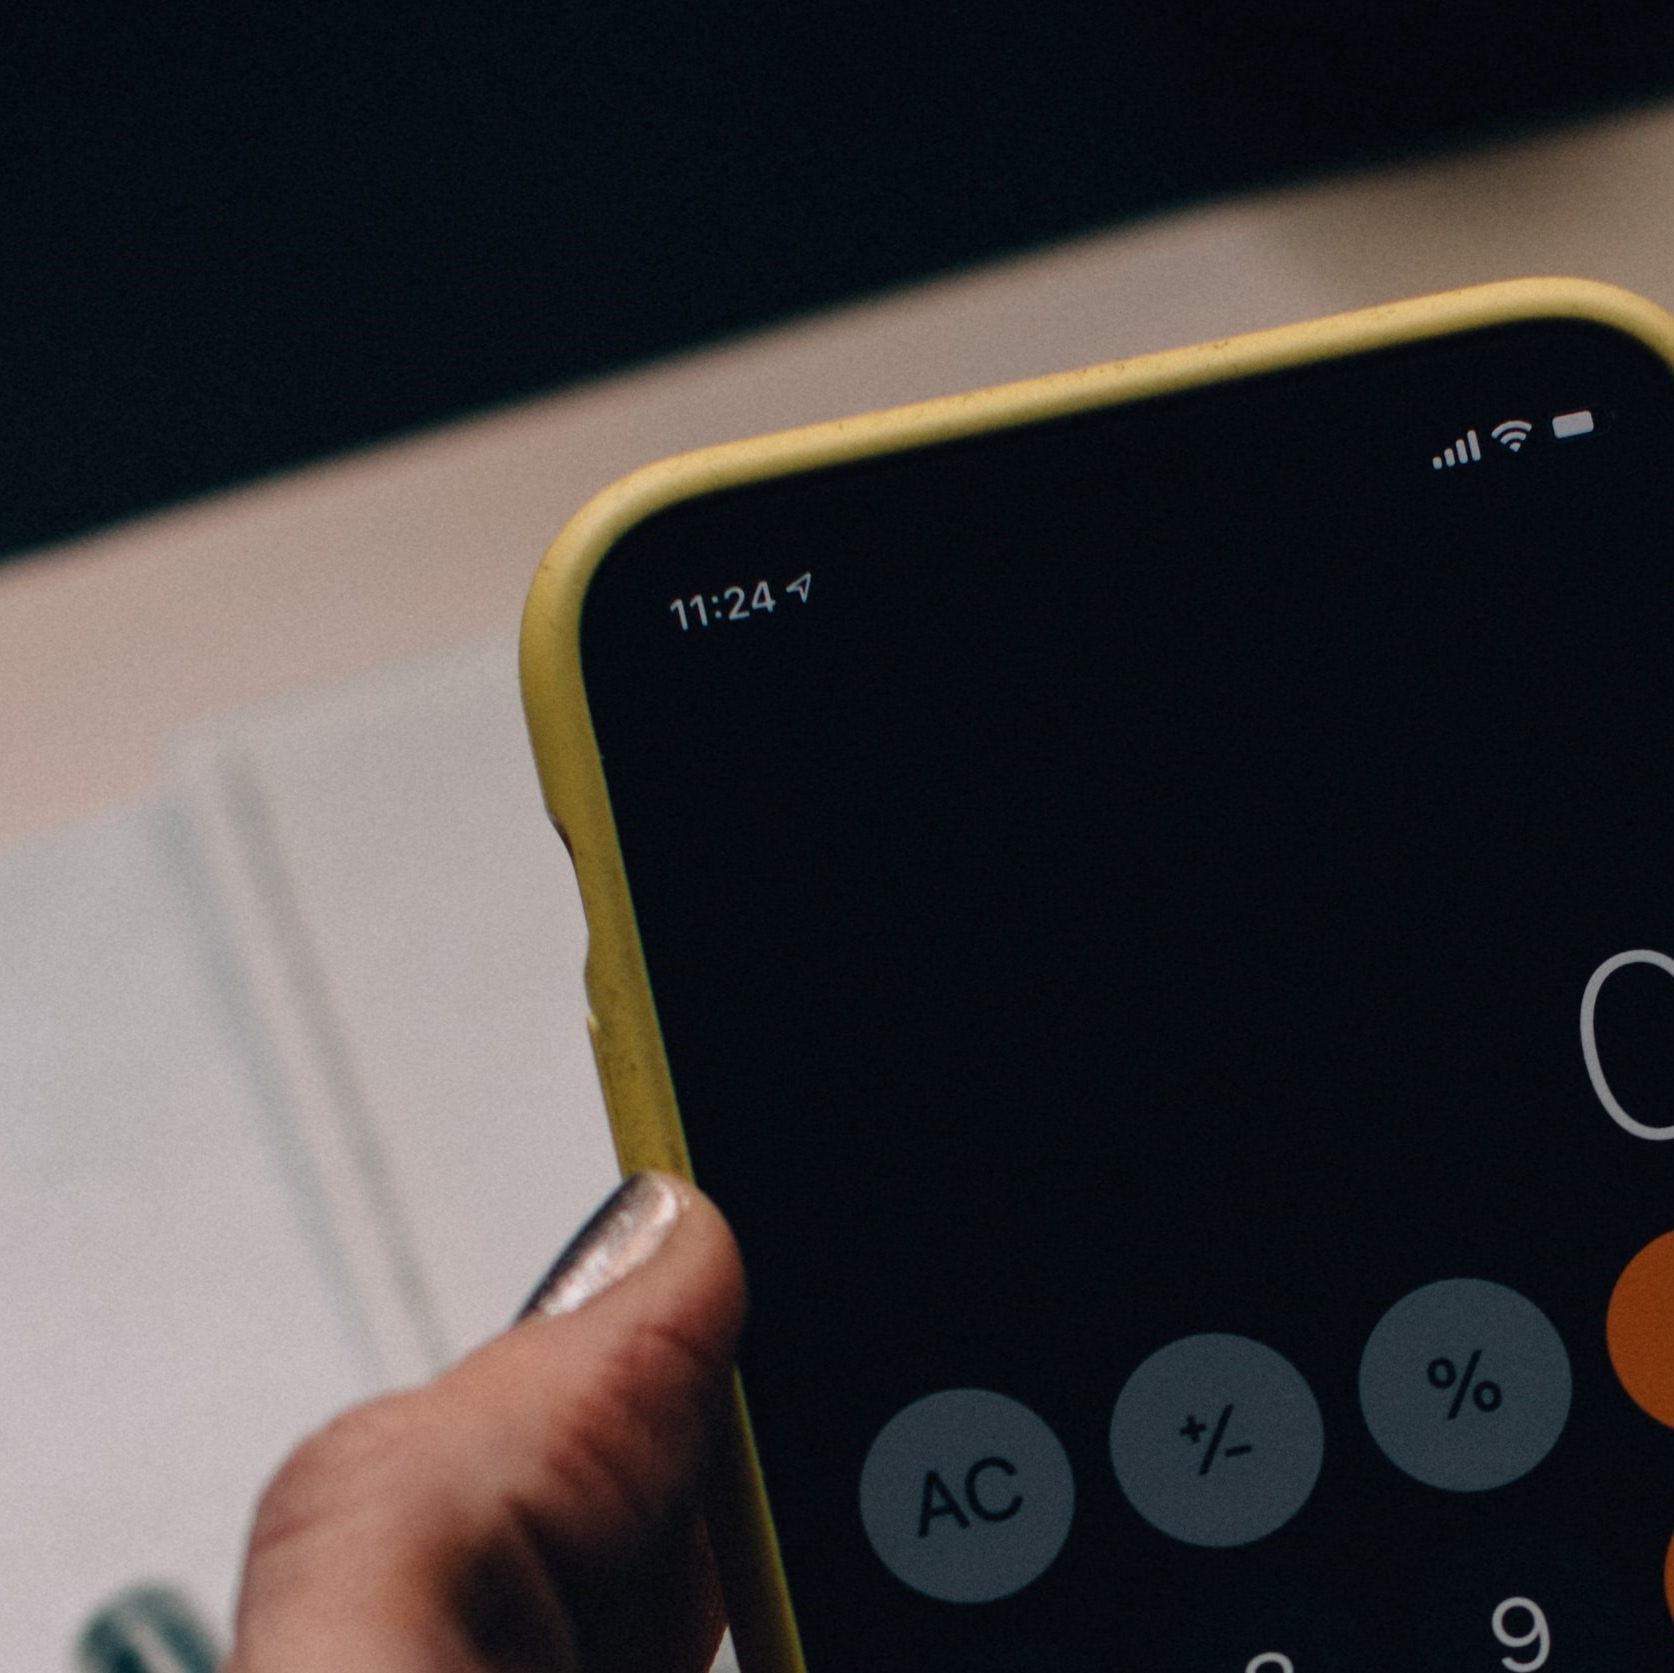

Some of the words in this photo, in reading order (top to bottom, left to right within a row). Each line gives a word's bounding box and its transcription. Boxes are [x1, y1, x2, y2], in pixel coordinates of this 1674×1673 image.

[670, 572, 777, 630] 11:24
[917, 1455, 1025, 1539] AC
[1425, 1348, 1504, 1421] %
[1491, 1596, 1551, 1673] 9
